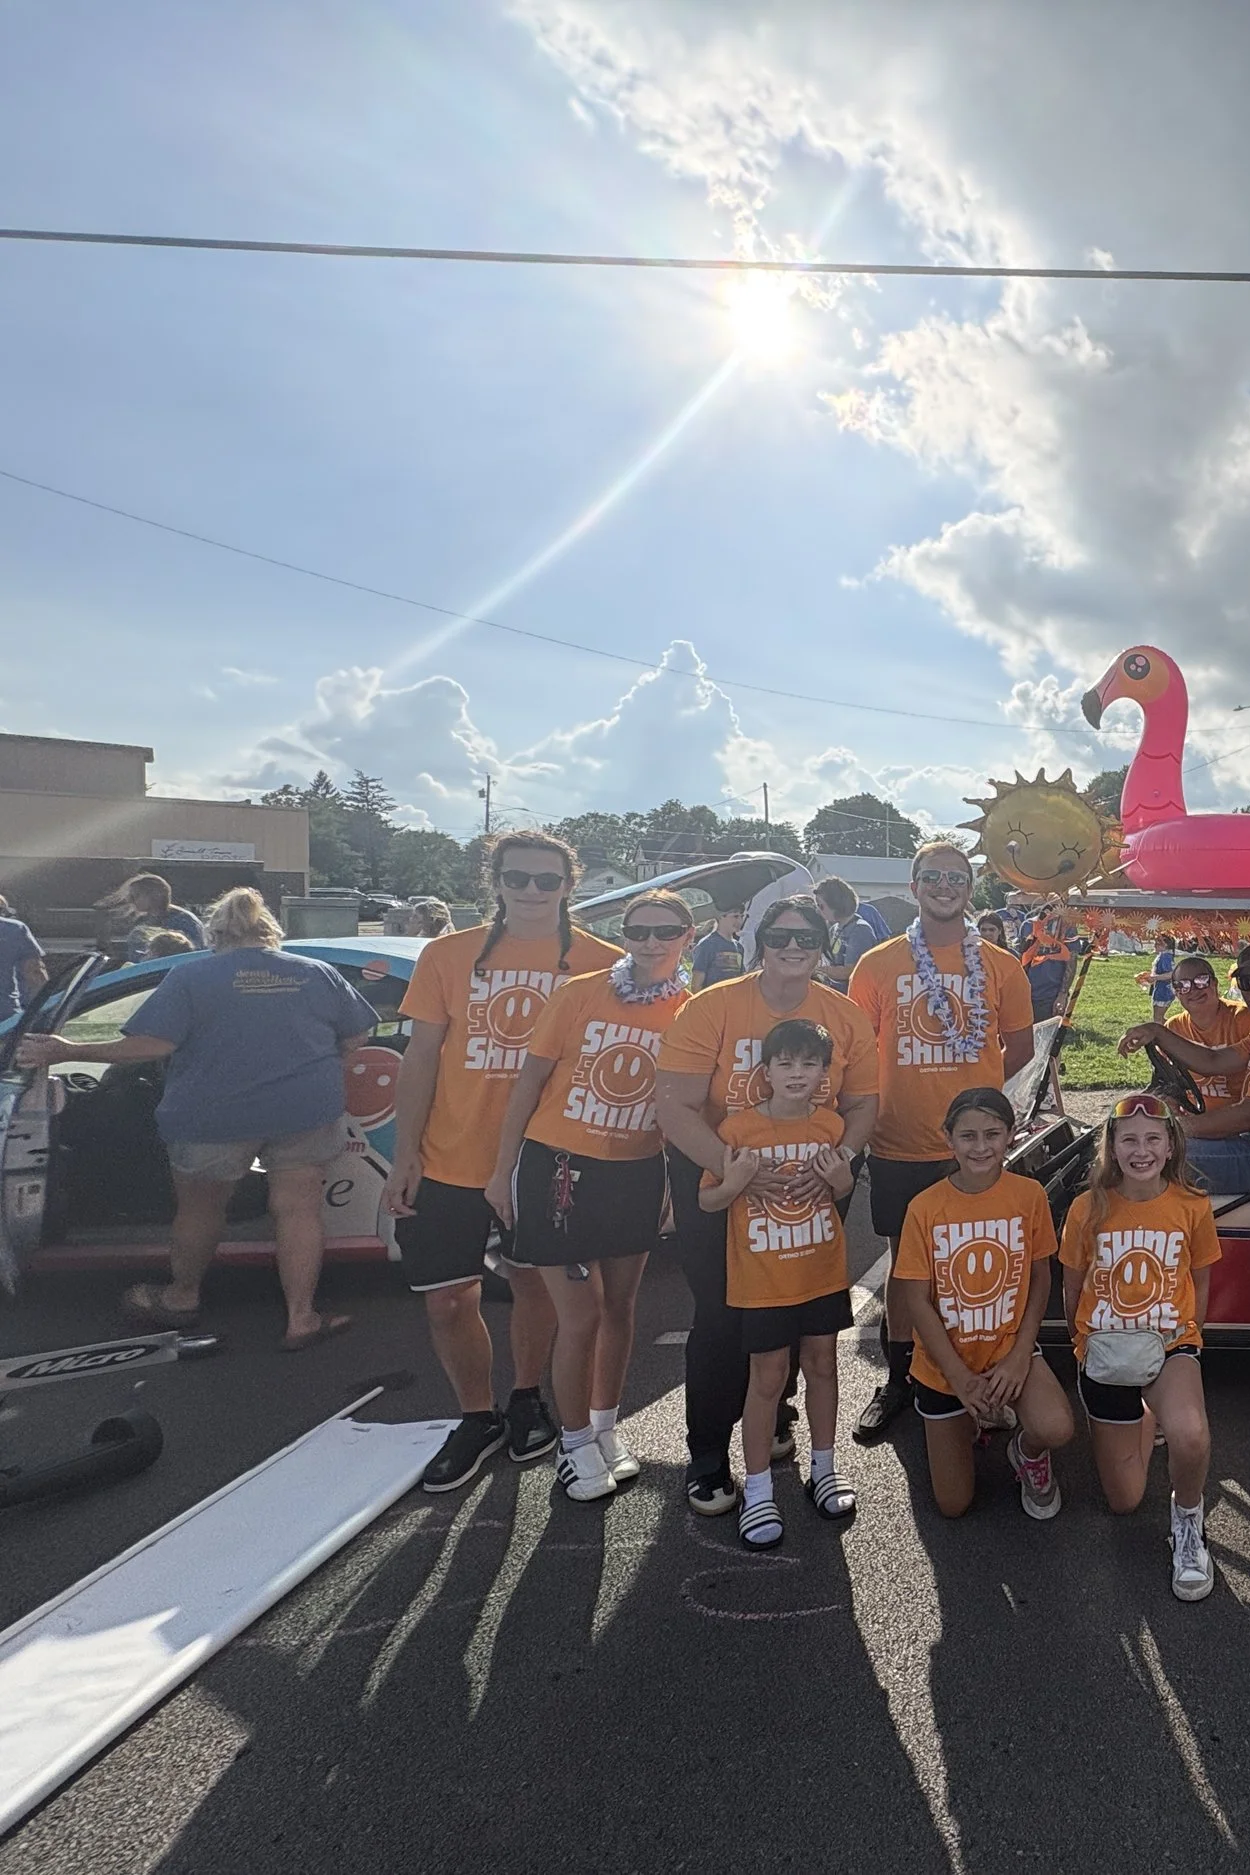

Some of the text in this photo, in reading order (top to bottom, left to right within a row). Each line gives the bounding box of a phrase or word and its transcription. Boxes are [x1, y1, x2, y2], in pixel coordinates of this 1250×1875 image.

[581, 1021, 661, 1059] SHIN
[748, 1208, 835, 1253] SHINE
[932, 1216, 1025, 1260] SHINE
[1096, 1229, 1185, 1268] SHINE
[938, 1288, 1019, 1334] SHINE
[19, 1348, 147, 1378] Micro
